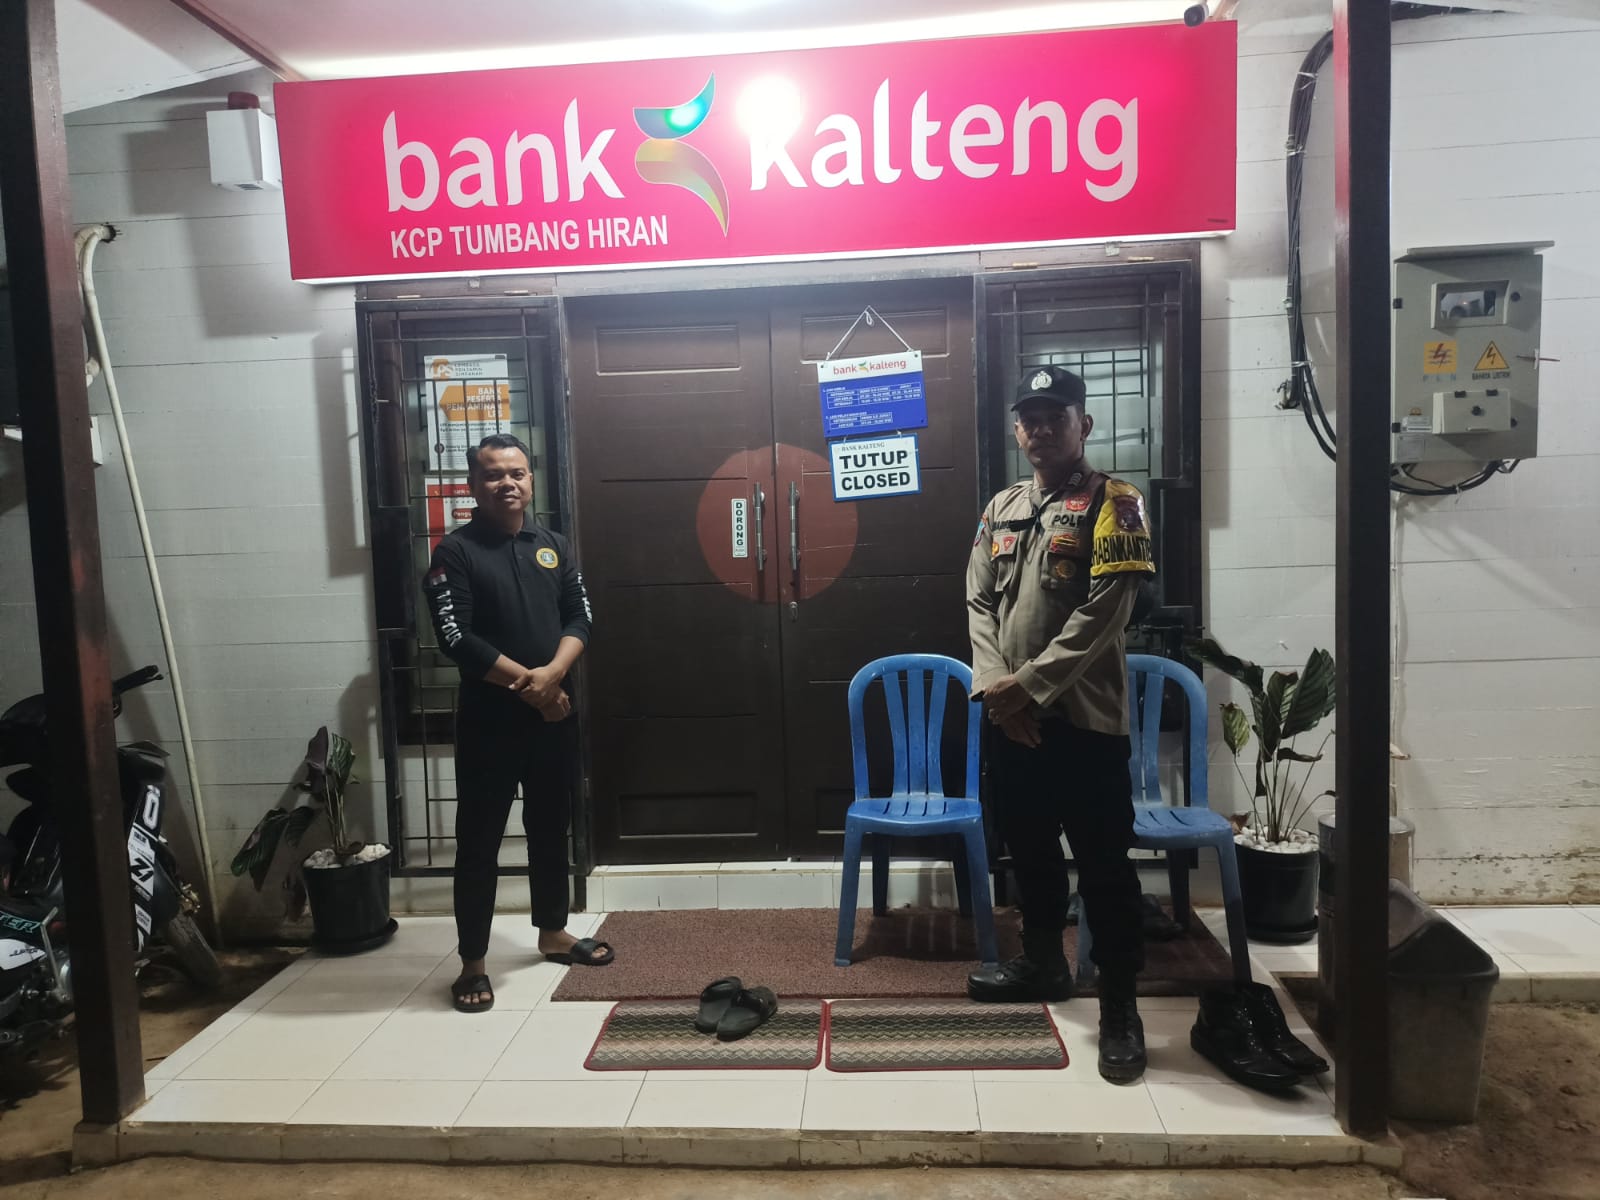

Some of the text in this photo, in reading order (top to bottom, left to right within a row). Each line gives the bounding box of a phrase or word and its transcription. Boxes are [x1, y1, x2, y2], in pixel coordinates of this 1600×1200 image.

[383, 97, 625, 213] bank
[390, 215, 669, 258] KCP TUMBANG HIRAN
[833, 359, 907, 375] bank kalteng
[858, 442, 886, 450] KALTENG
[839, 450, 908, 469] TUTUP
[841, 471, 911, 491] CLOSED
[735, 502, 744, 546] DORONG
